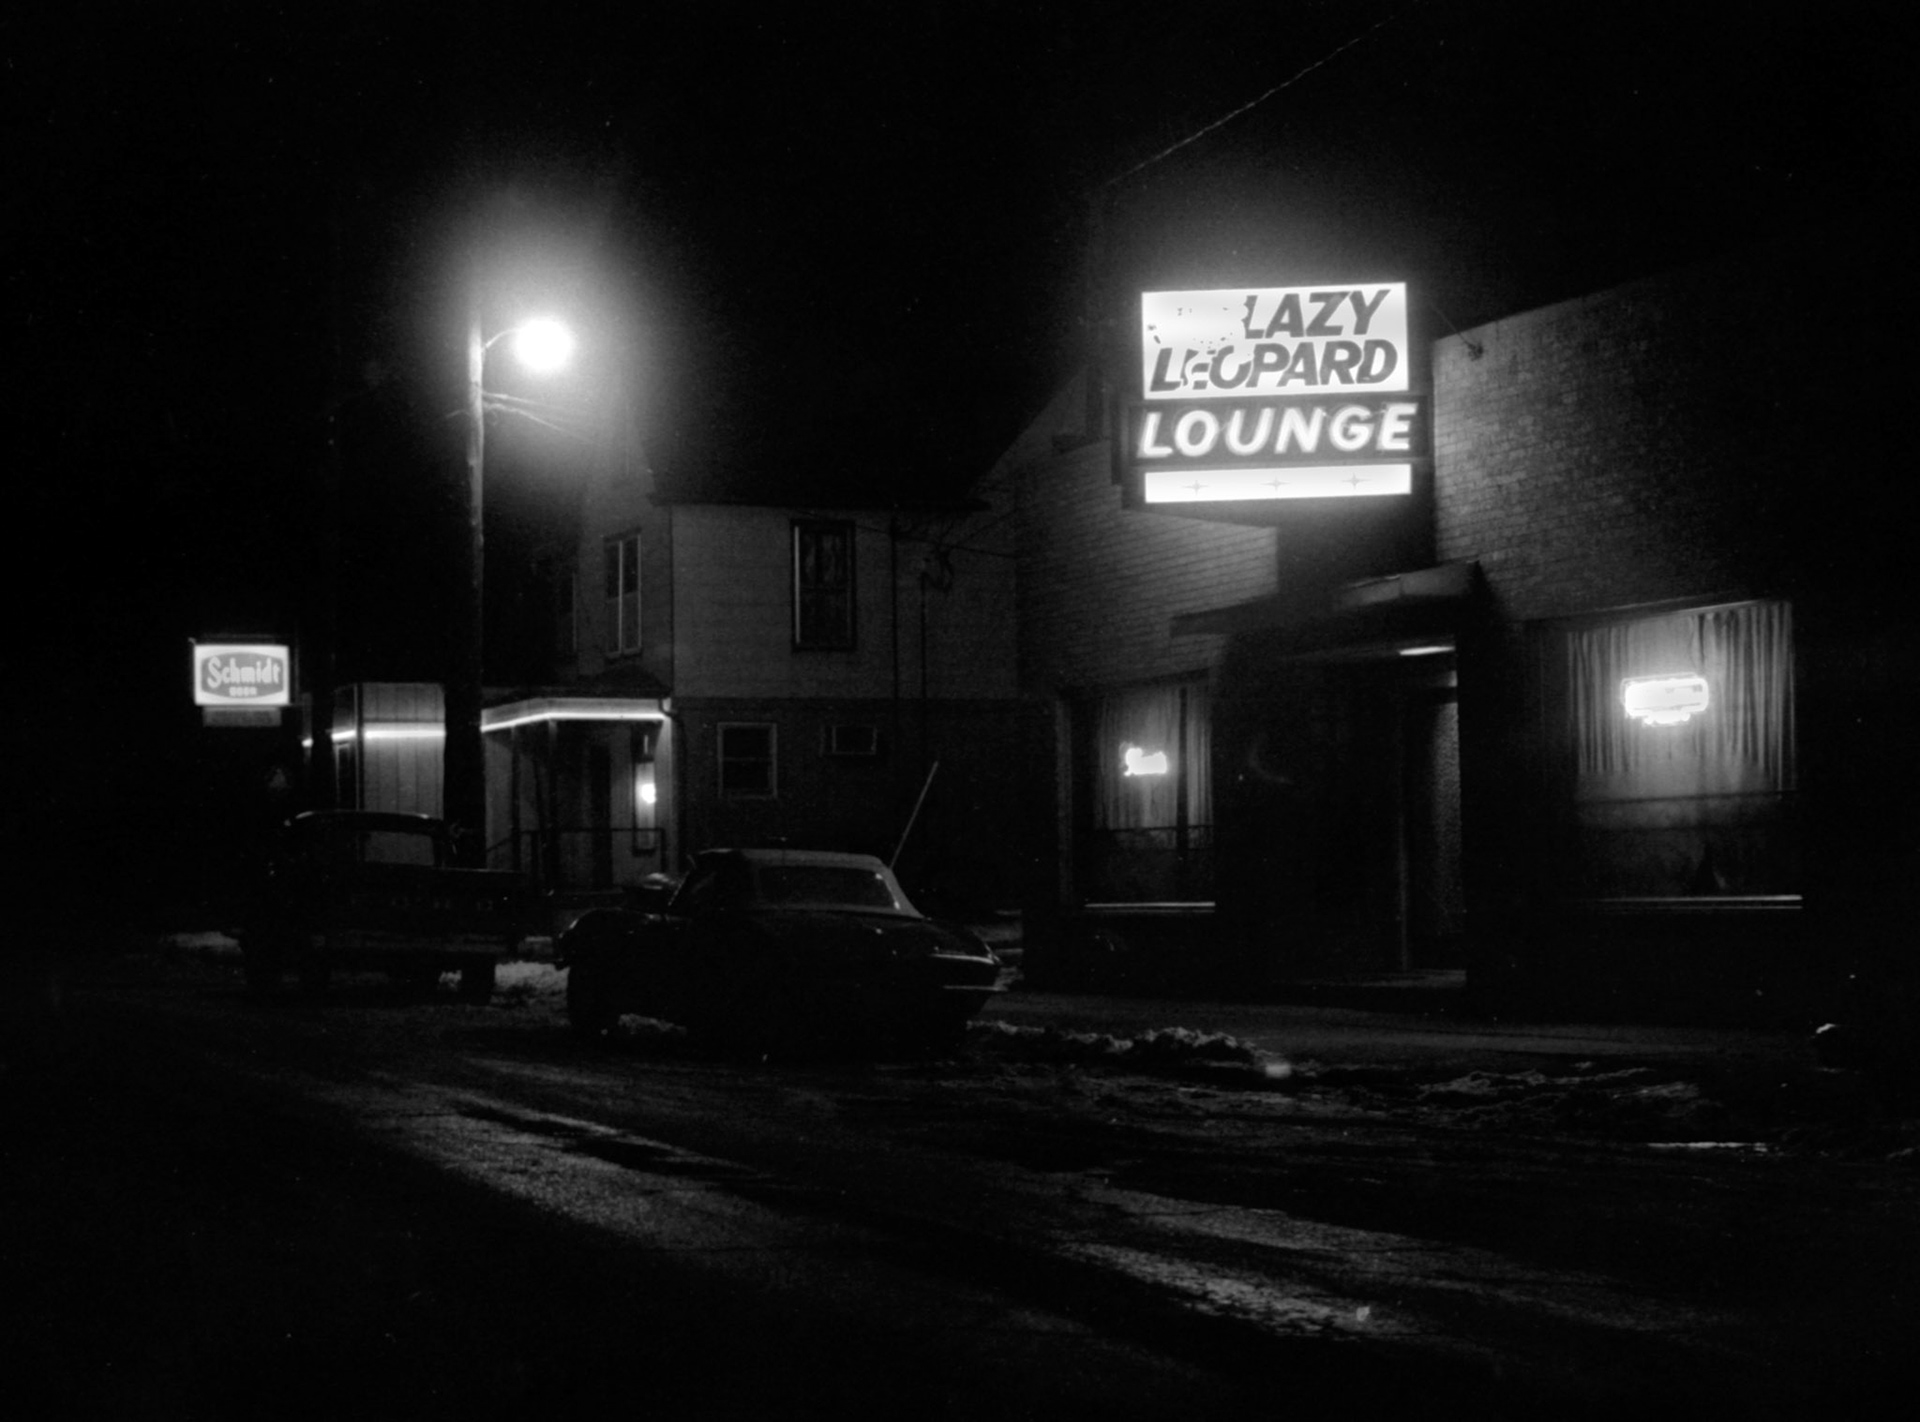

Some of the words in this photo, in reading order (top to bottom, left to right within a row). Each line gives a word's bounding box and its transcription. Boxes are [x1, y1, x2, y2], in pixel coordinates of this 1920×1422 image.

[1241, 289, 1391, 339] LAZY
[1137, 402, 1418, 458] LOUNGE
[207, 656, 280, 688] Schmidt
